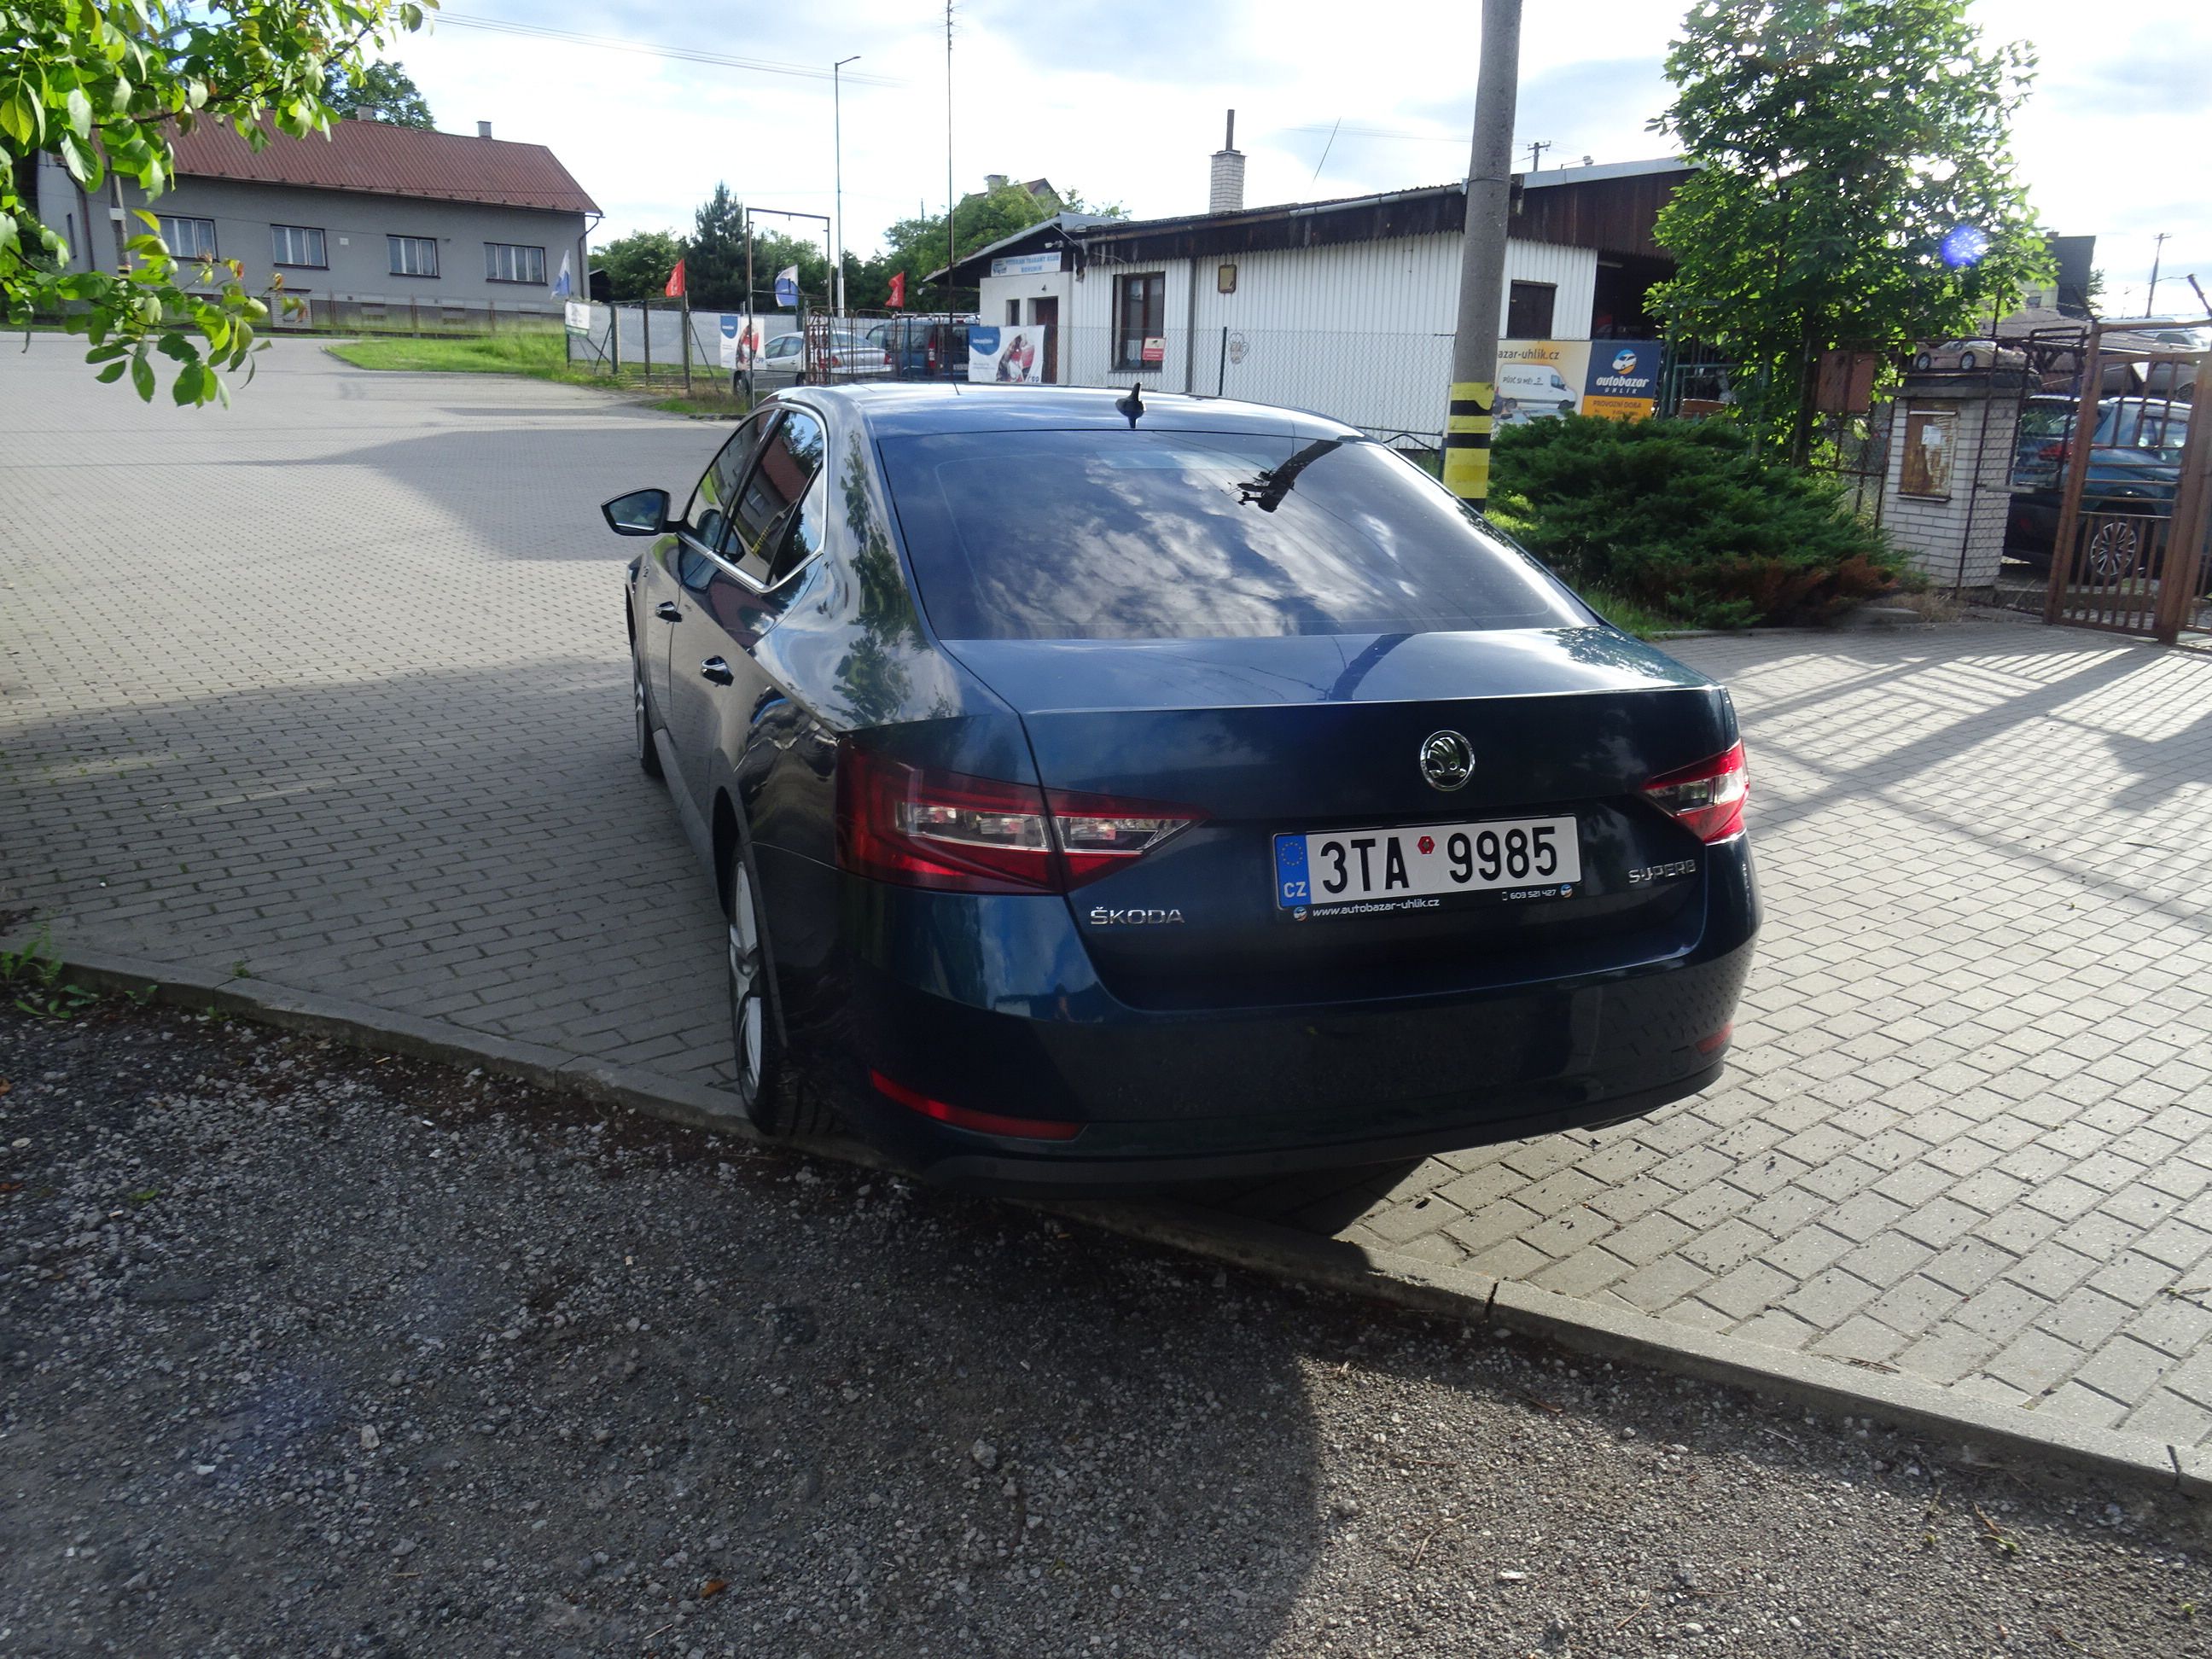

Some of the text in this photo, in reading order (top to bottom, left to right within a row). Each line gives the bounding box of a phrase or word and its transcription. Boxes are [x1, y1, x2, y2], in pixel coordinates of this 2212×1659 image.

[1498, 348, 1560, 360] azar-uhlik.cz
[1596, 375, 1650, 387] autobazar
[1319, 826, 1557, 894] 3TA 9985
[1628, 859, 1697, 884] SUPERB
[1284, 882, 1307, 899] CZ
[1510, 891, 1527, 899] 603
[1090, 906, 1185, 925] ŠKODA
[1313, 899, 1440, 917] www.autobazar-uhlik.cz
